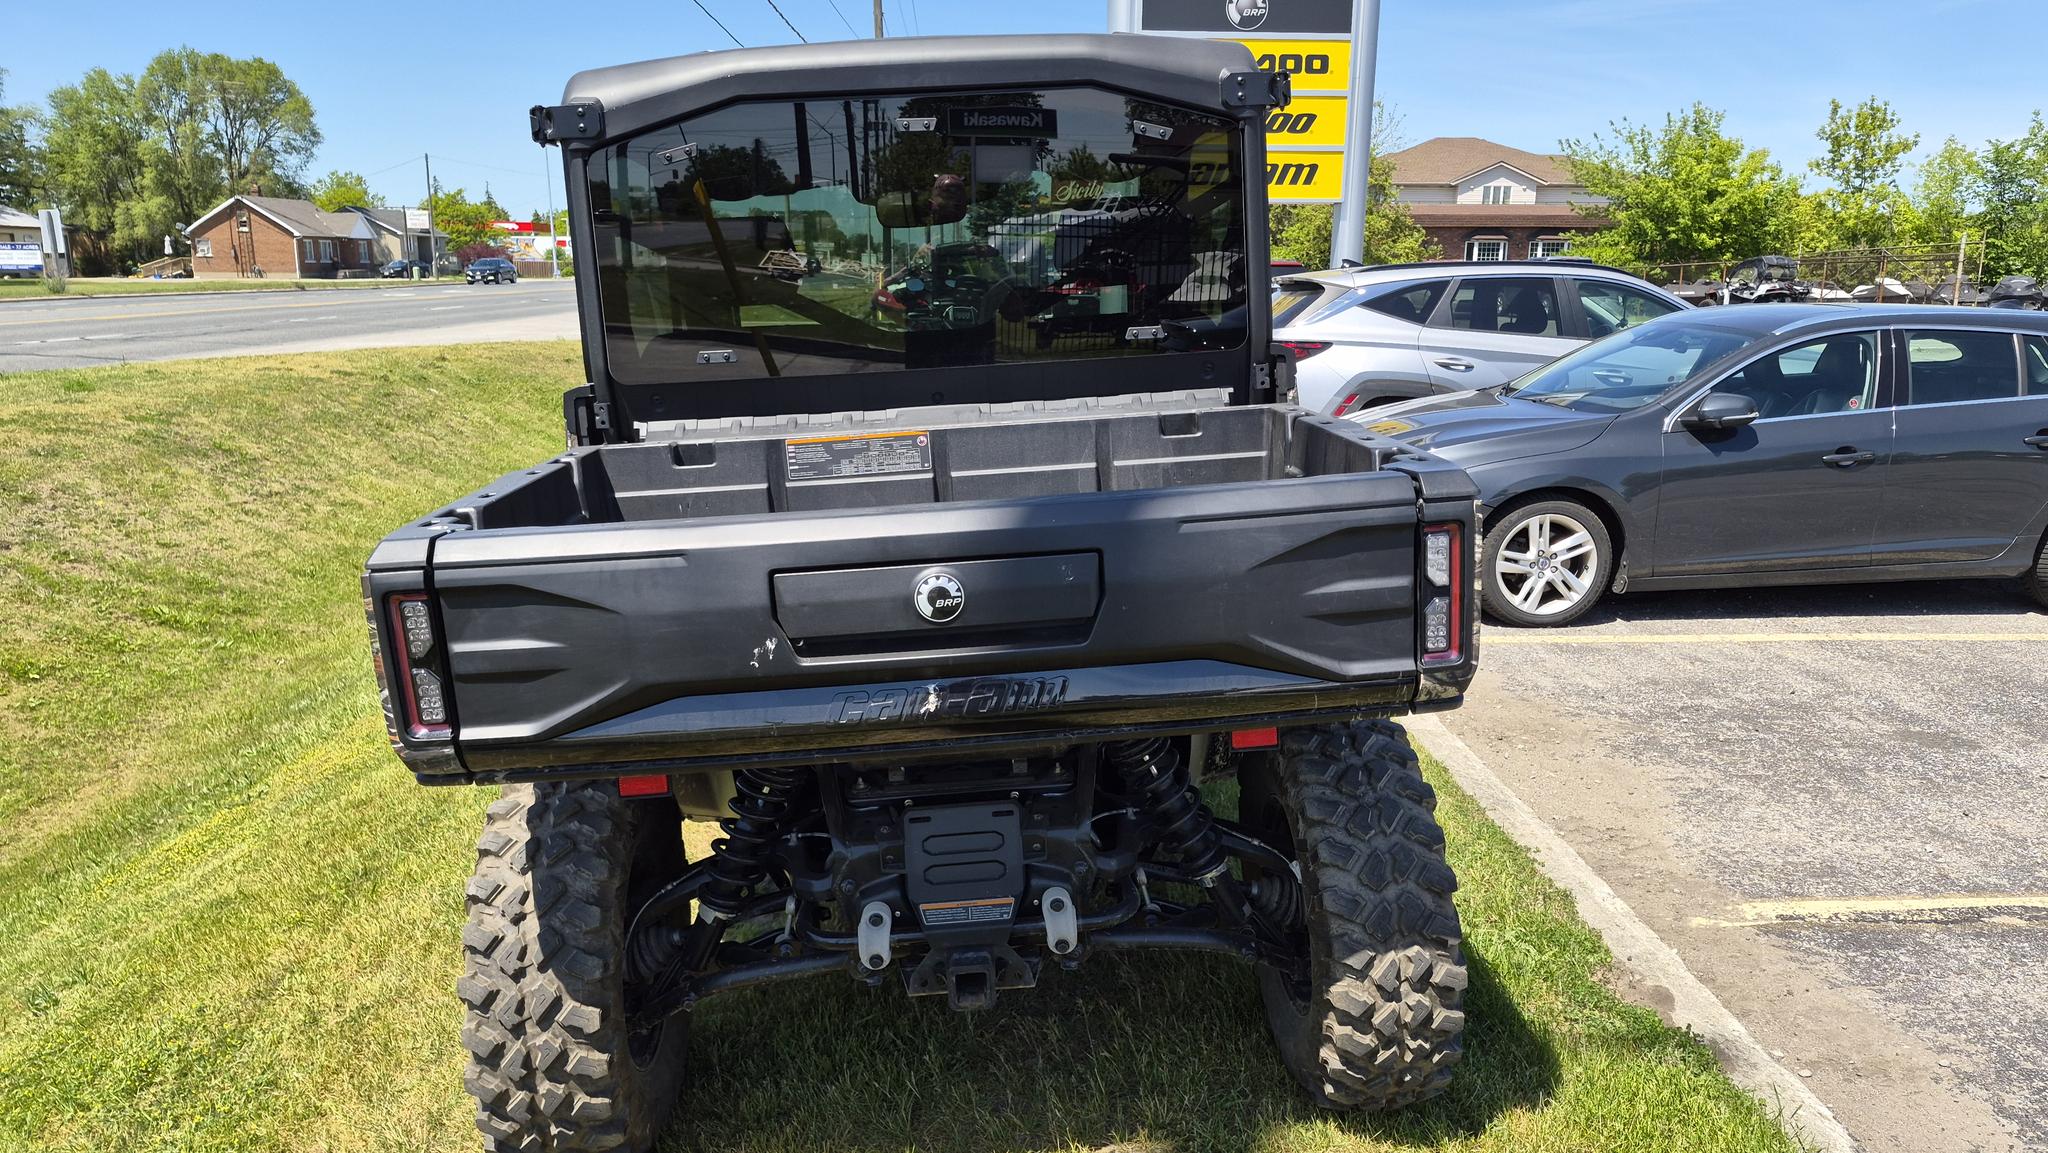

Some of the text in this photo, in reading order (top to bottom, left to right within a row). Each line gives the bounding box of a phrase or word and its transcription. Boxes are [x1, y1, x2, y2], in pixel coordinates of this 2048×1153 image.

[1243, 8, 1266, 16] BRP
[1266, 113, 1318, 133] oo
[1056, 180, 1104, 201] Sicily
[935, 598, 962, 607] BRP
